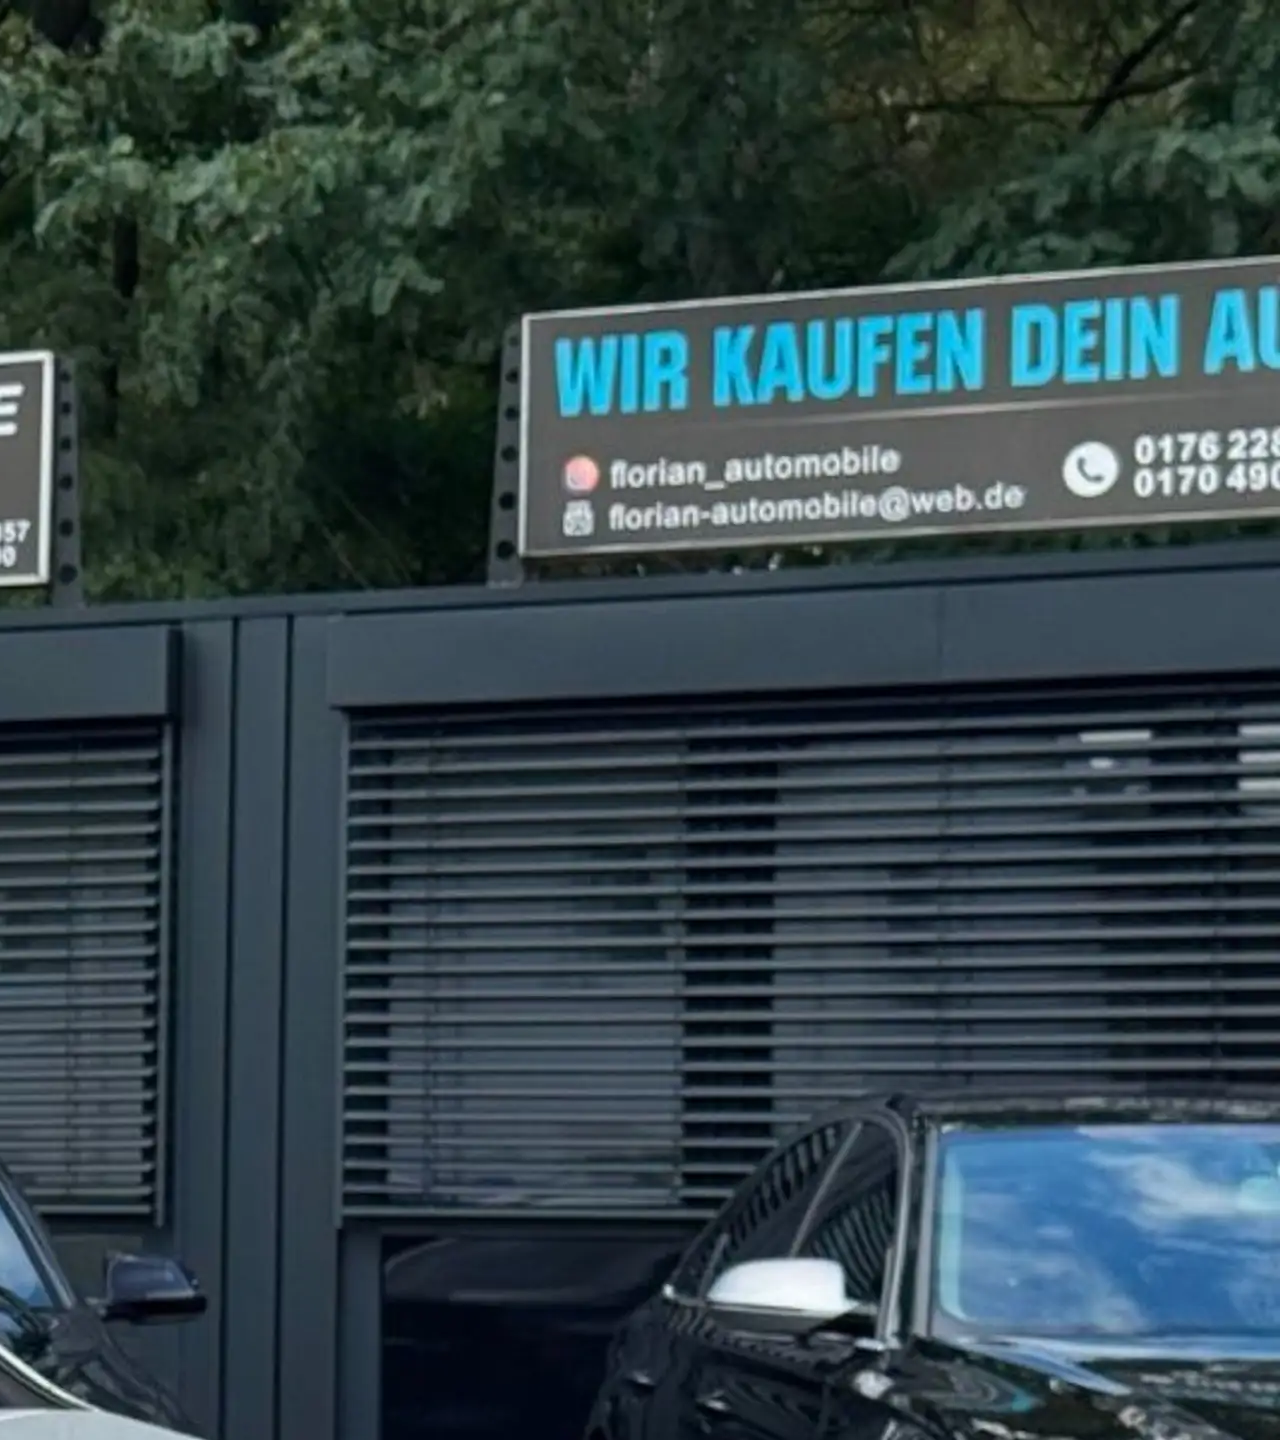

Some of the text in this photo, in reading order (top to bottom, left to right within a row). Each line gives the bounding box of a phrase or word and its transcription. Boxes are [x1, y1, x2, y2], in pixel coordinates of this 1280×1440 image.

[555, 331, 688, 417] WIR
[713, 307, 985, 408] KAUFEN
[1011, 294, 1180, 388] DEIN
[609, 445, 902, 491] florian_automobile
[1134, 430, 1221, 464] 0176
[1133, 464, 1219, 498] 0170
[608, 481, 1027, 531] florian-automobile@web.de
